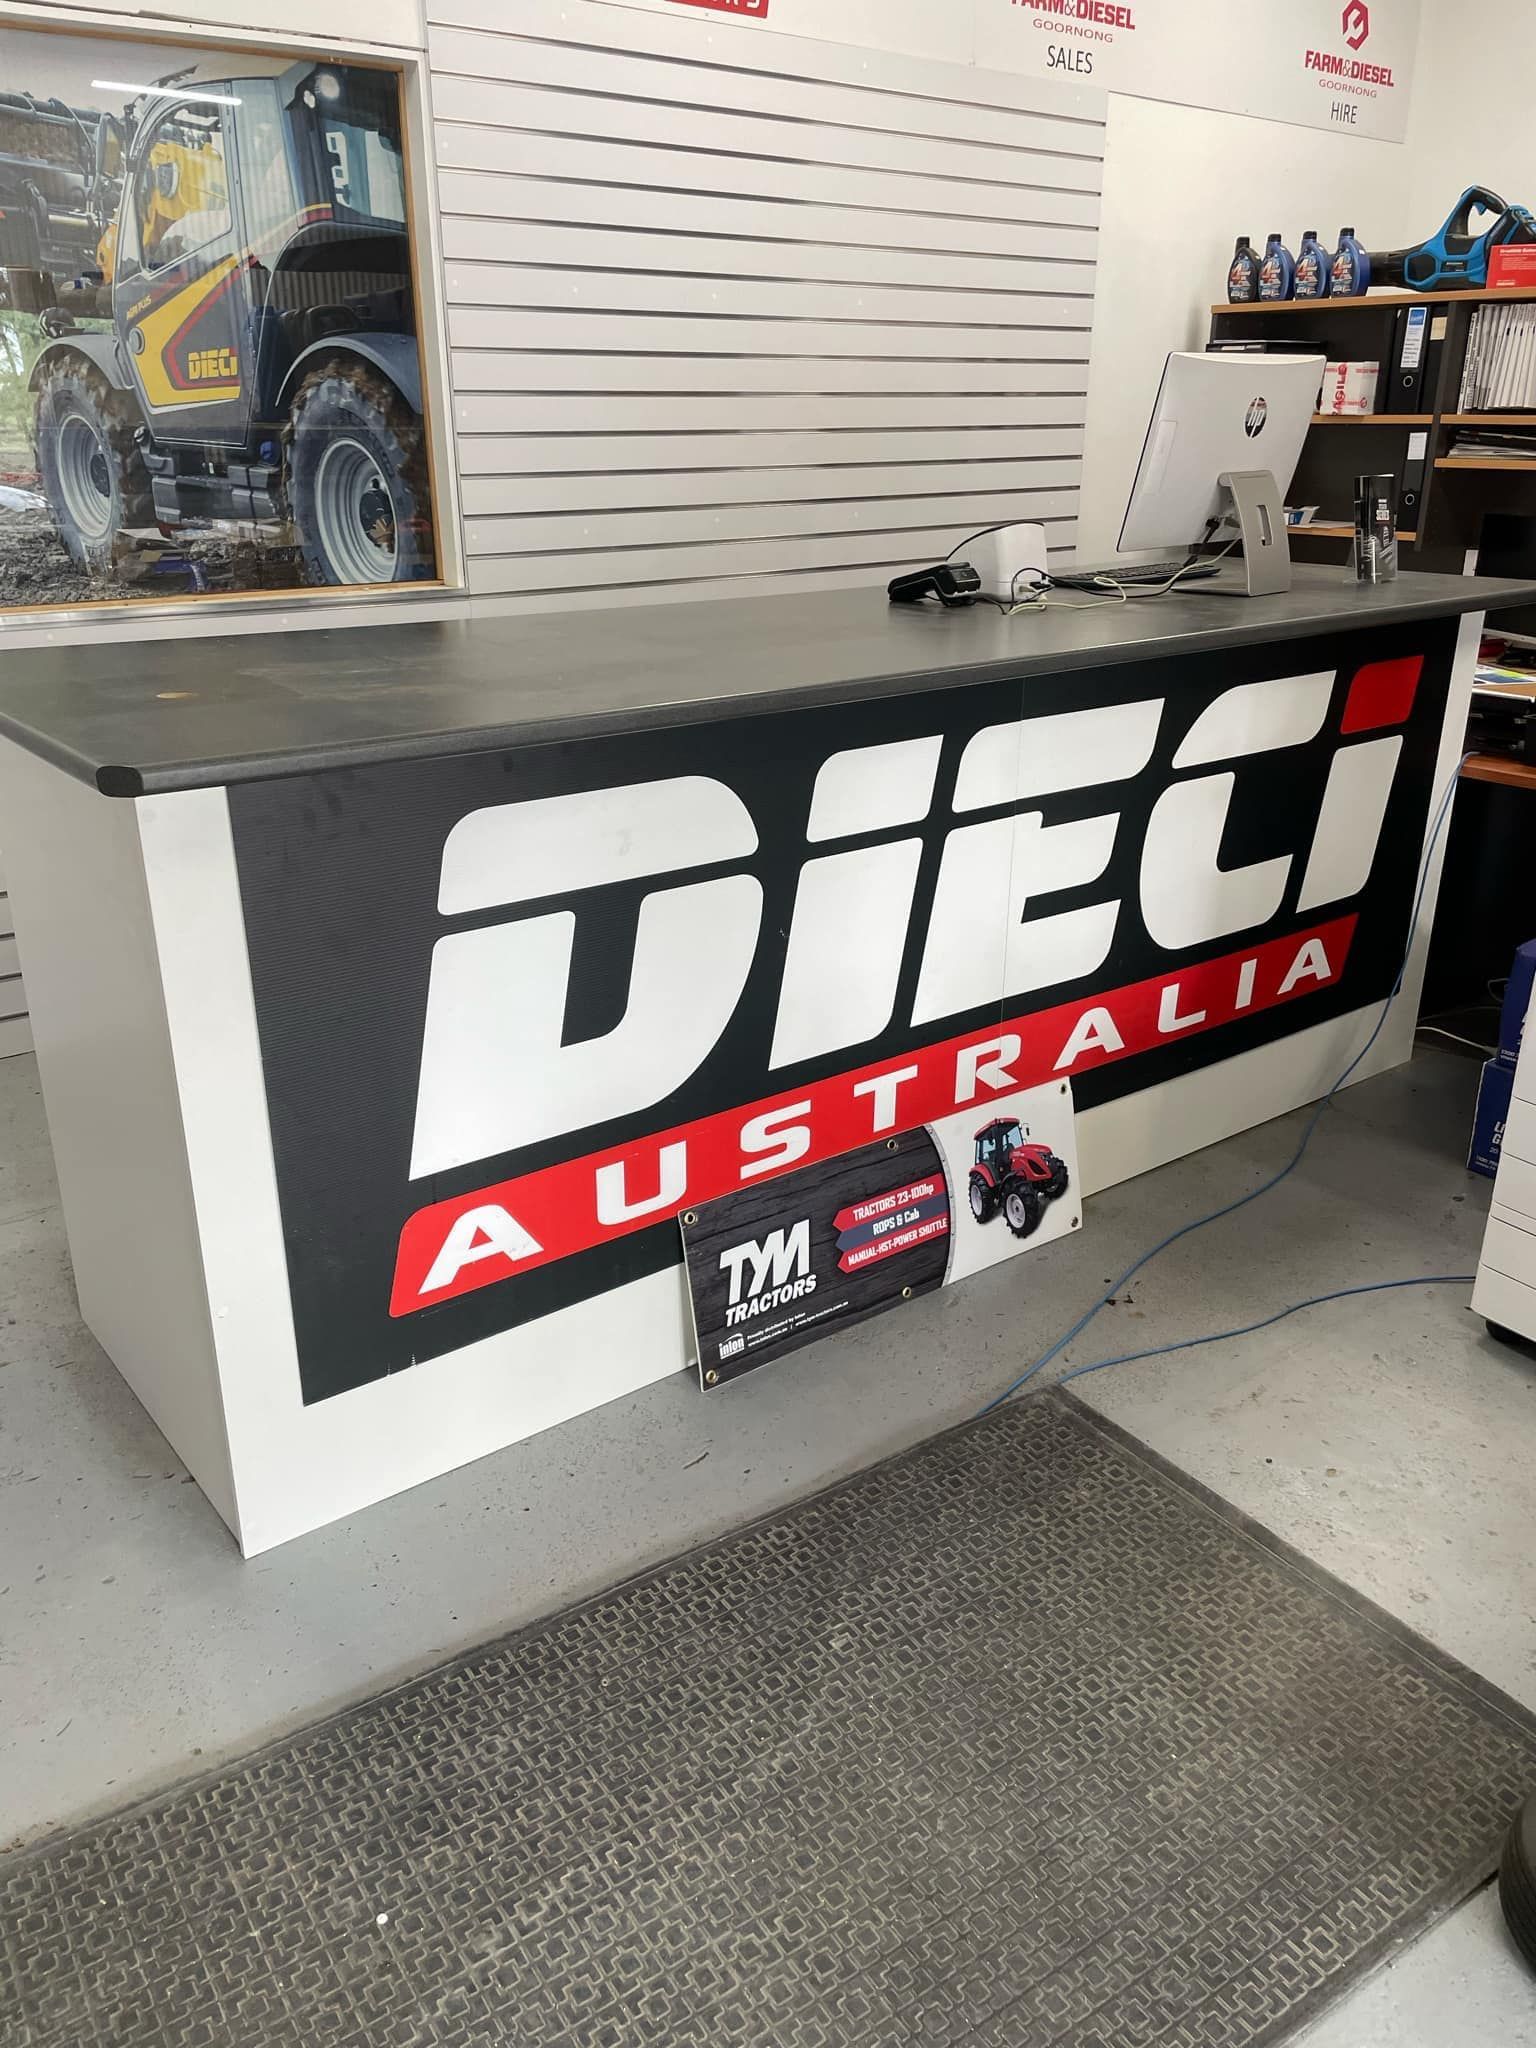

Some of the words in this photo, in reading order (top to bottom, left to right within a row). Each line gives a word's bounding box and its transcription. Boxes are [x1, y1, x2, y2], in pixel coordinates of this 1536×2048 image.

[1033, 18, 1113, 43] GOORNONG
[1046, 45, 1093, 74] SALES
[1318, 79, 1377, 98] GOORNONG
[1330, 101, 1358, 124] HIRE
[188, 348, 238, 380] DIECI
[1247, 397, 1265, 438] hp
[409, 654, 1423, 1181] DIECI
[417, 937, 1334, 1295] AUSTRALIA
[853, 1196, 896, 1221] TRACTORS
[896, 1183, 934, 1205] 23-100hp
[872, 1217, 896, 1235] ROPS
[904, 1208, 920, 1223] Cab
[847, 1231, 918, 1266] MANUAL-HST-POWER
[918, 1217, 948, 1238] SHUTTLE
[719, 1219, 810, 1306] TYM
[725, 1274, 817, 1328] TRACTORS
